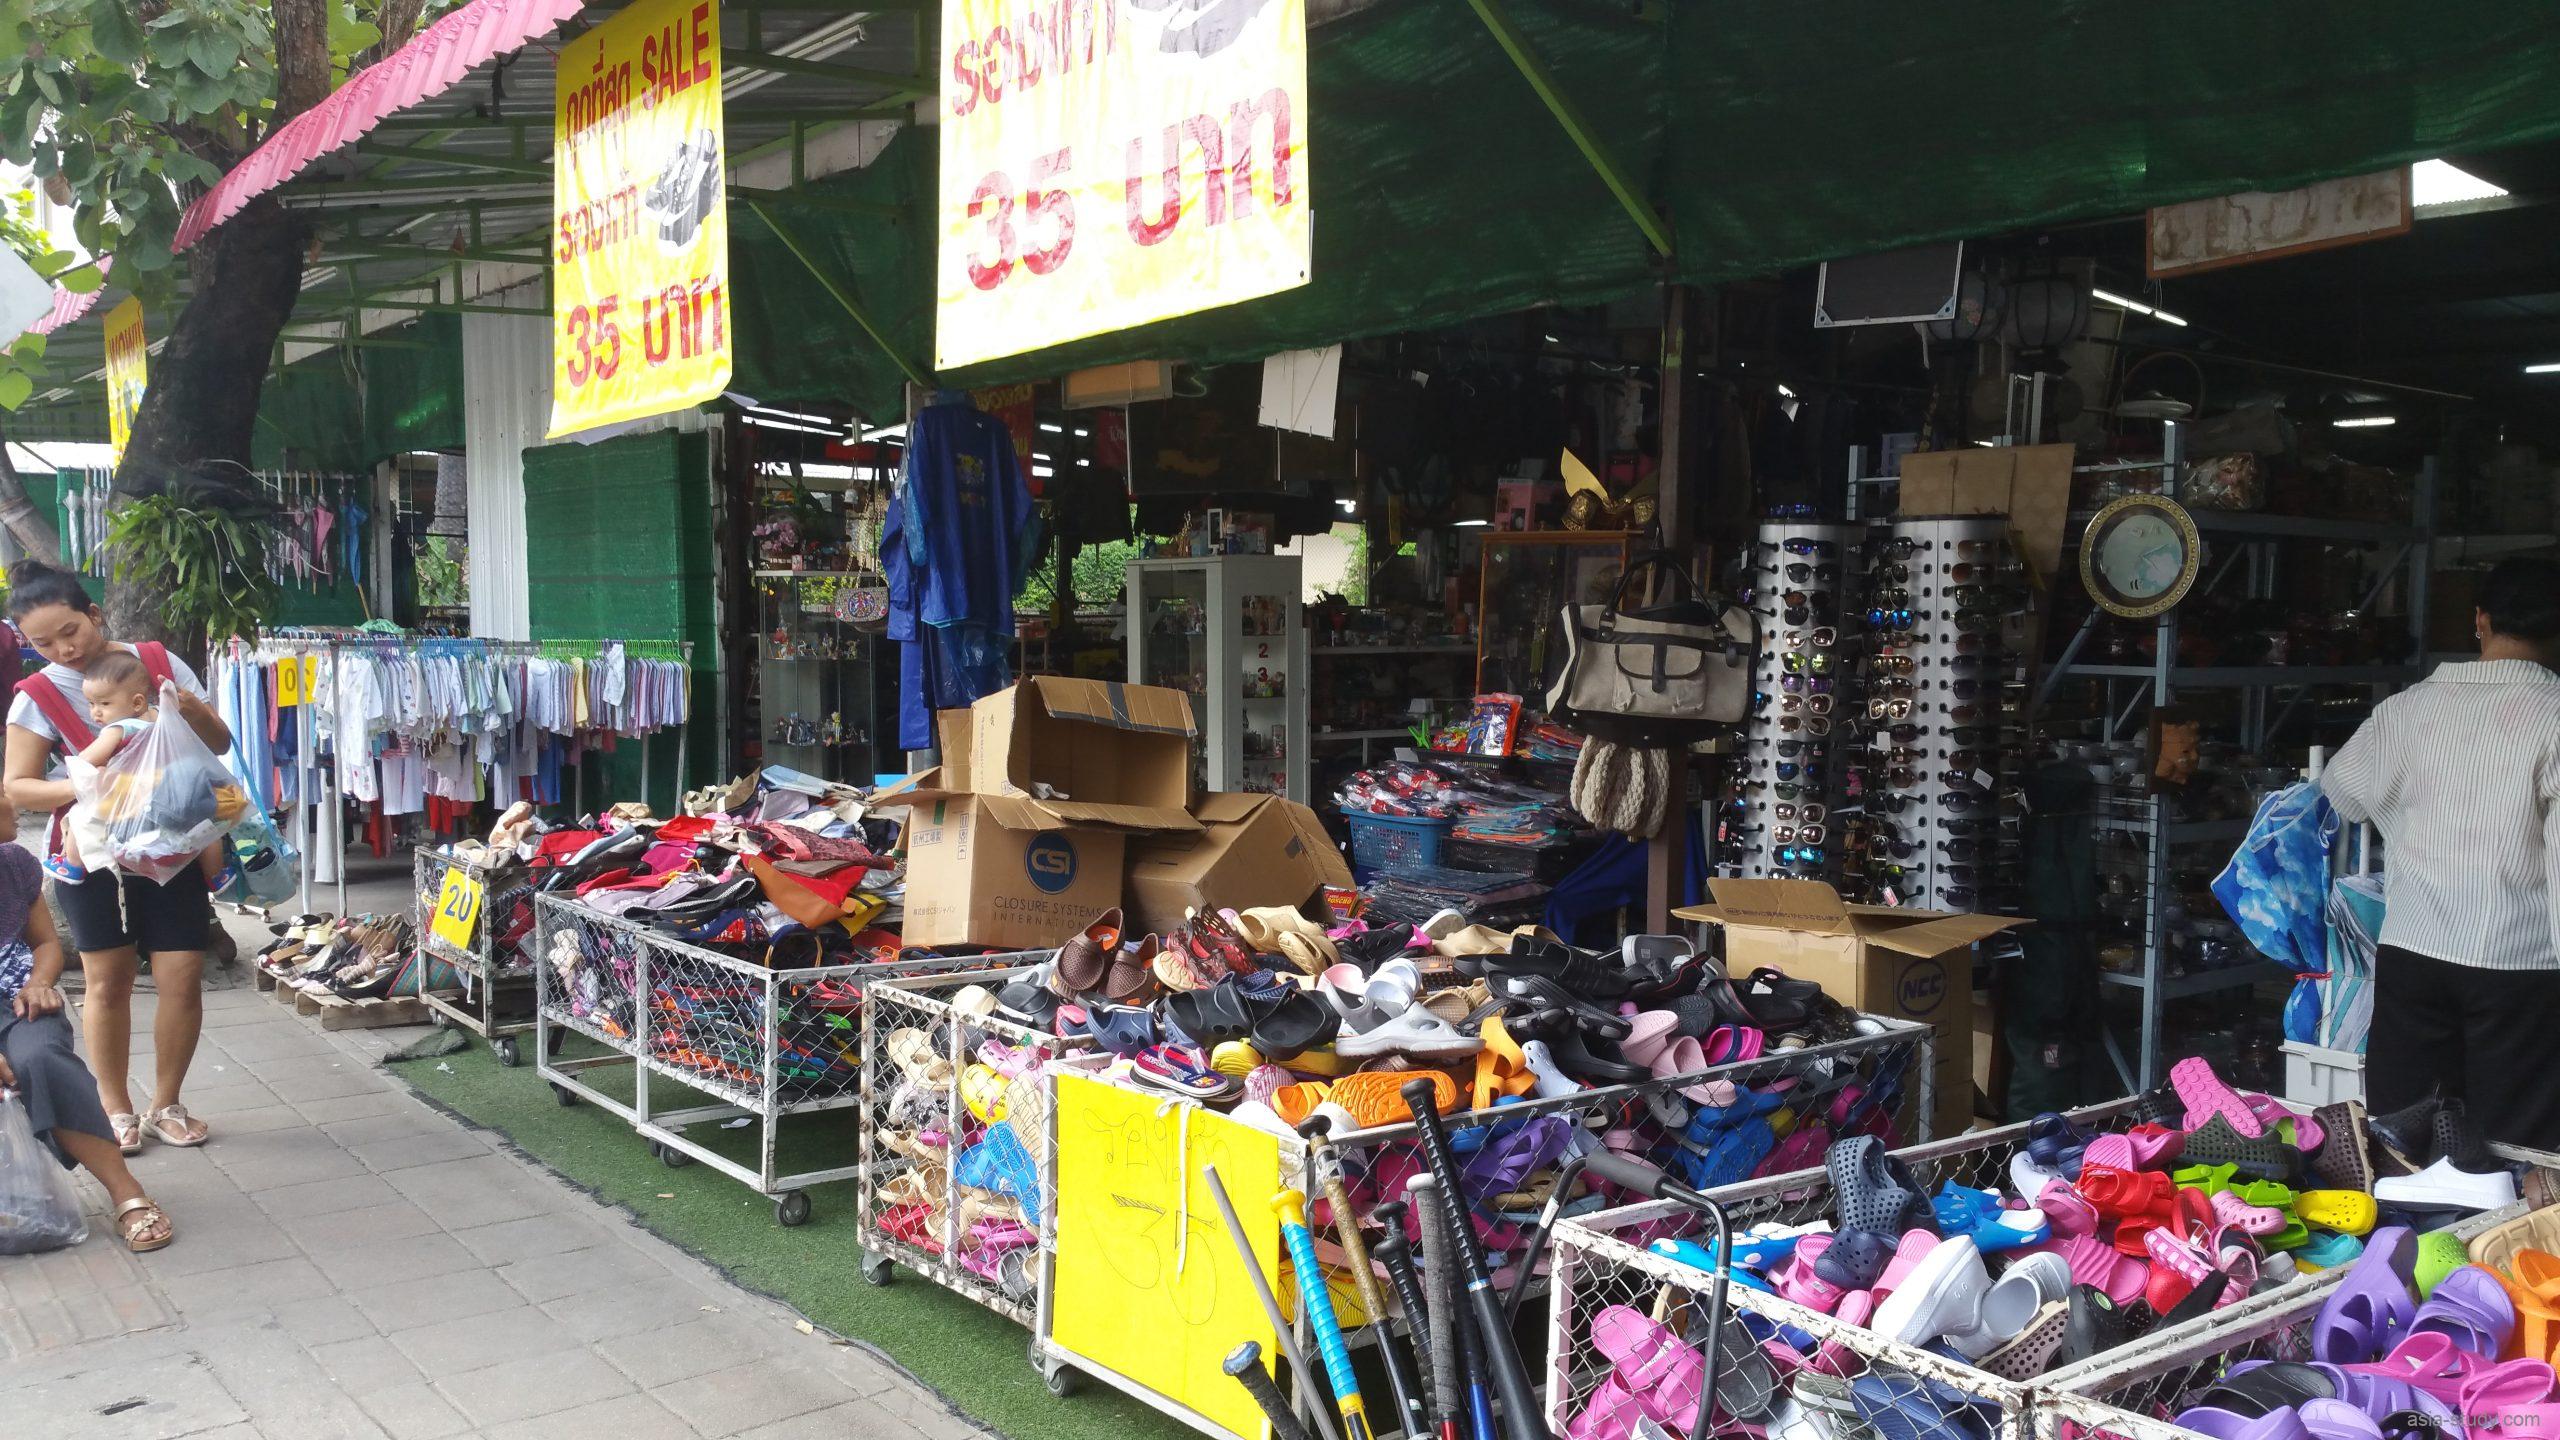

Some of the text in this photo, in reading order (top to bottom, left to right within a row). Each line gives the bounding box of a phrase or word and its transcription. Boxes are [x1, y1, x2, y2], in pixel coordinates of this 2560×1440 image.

[641, 2, 712, 111] SALE
[966, 87, 1293, 291] 35 บาท
[567, 272, 723, 387] 35 บาท
[1031, 848, 1070, 876] CSI
[445, 885, 473, 922] 20
[993, 896, 1101, 918] CLOSURE SYSTEMS
[993, 912, 1086, 930] INTERNATION
[1080, 1193, 1218, 1326] 35
